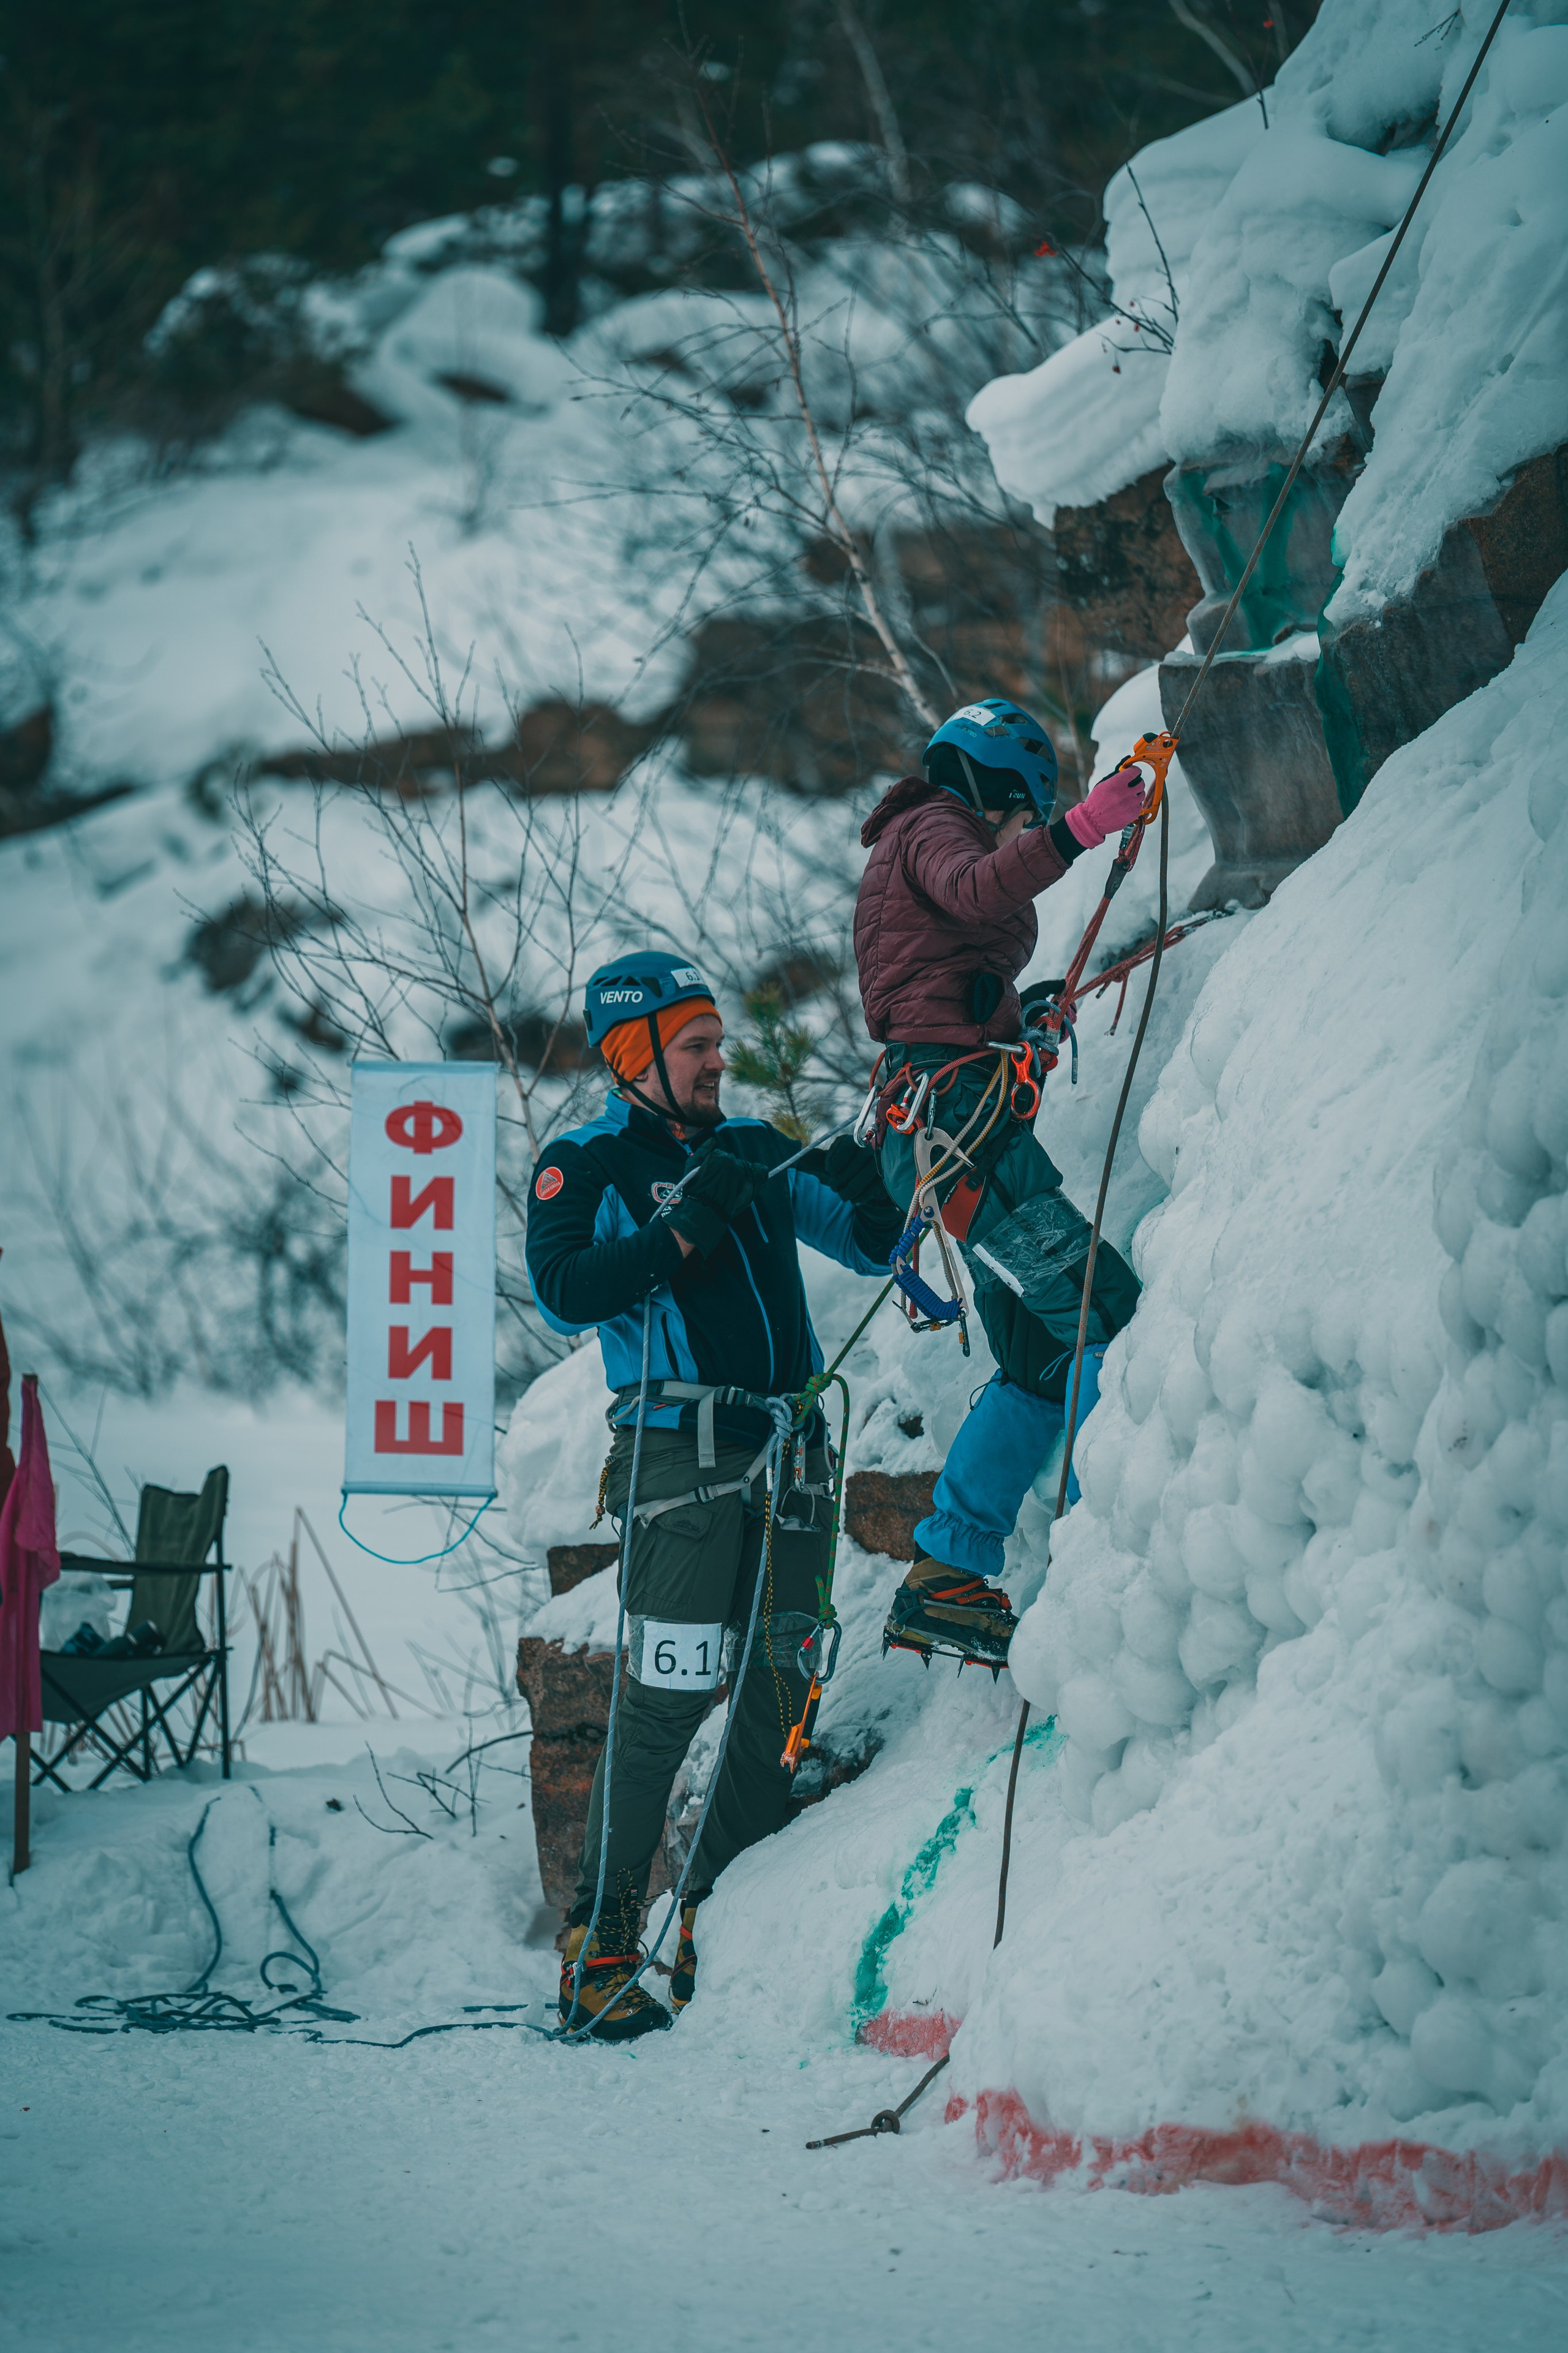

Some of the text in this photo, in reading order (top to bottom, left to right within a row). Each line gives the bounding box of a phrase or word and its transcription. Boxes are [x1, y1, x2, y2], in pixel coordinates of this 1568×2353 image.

[963, 709, 982, 719] 6.2
[685, 971, 700, 981] 6.1
[600, 990, 643, 1005] VENTO
[374, 1100, 464, 1456] ФИНИШ
[654, 1639, 712, 1676] 6.1
